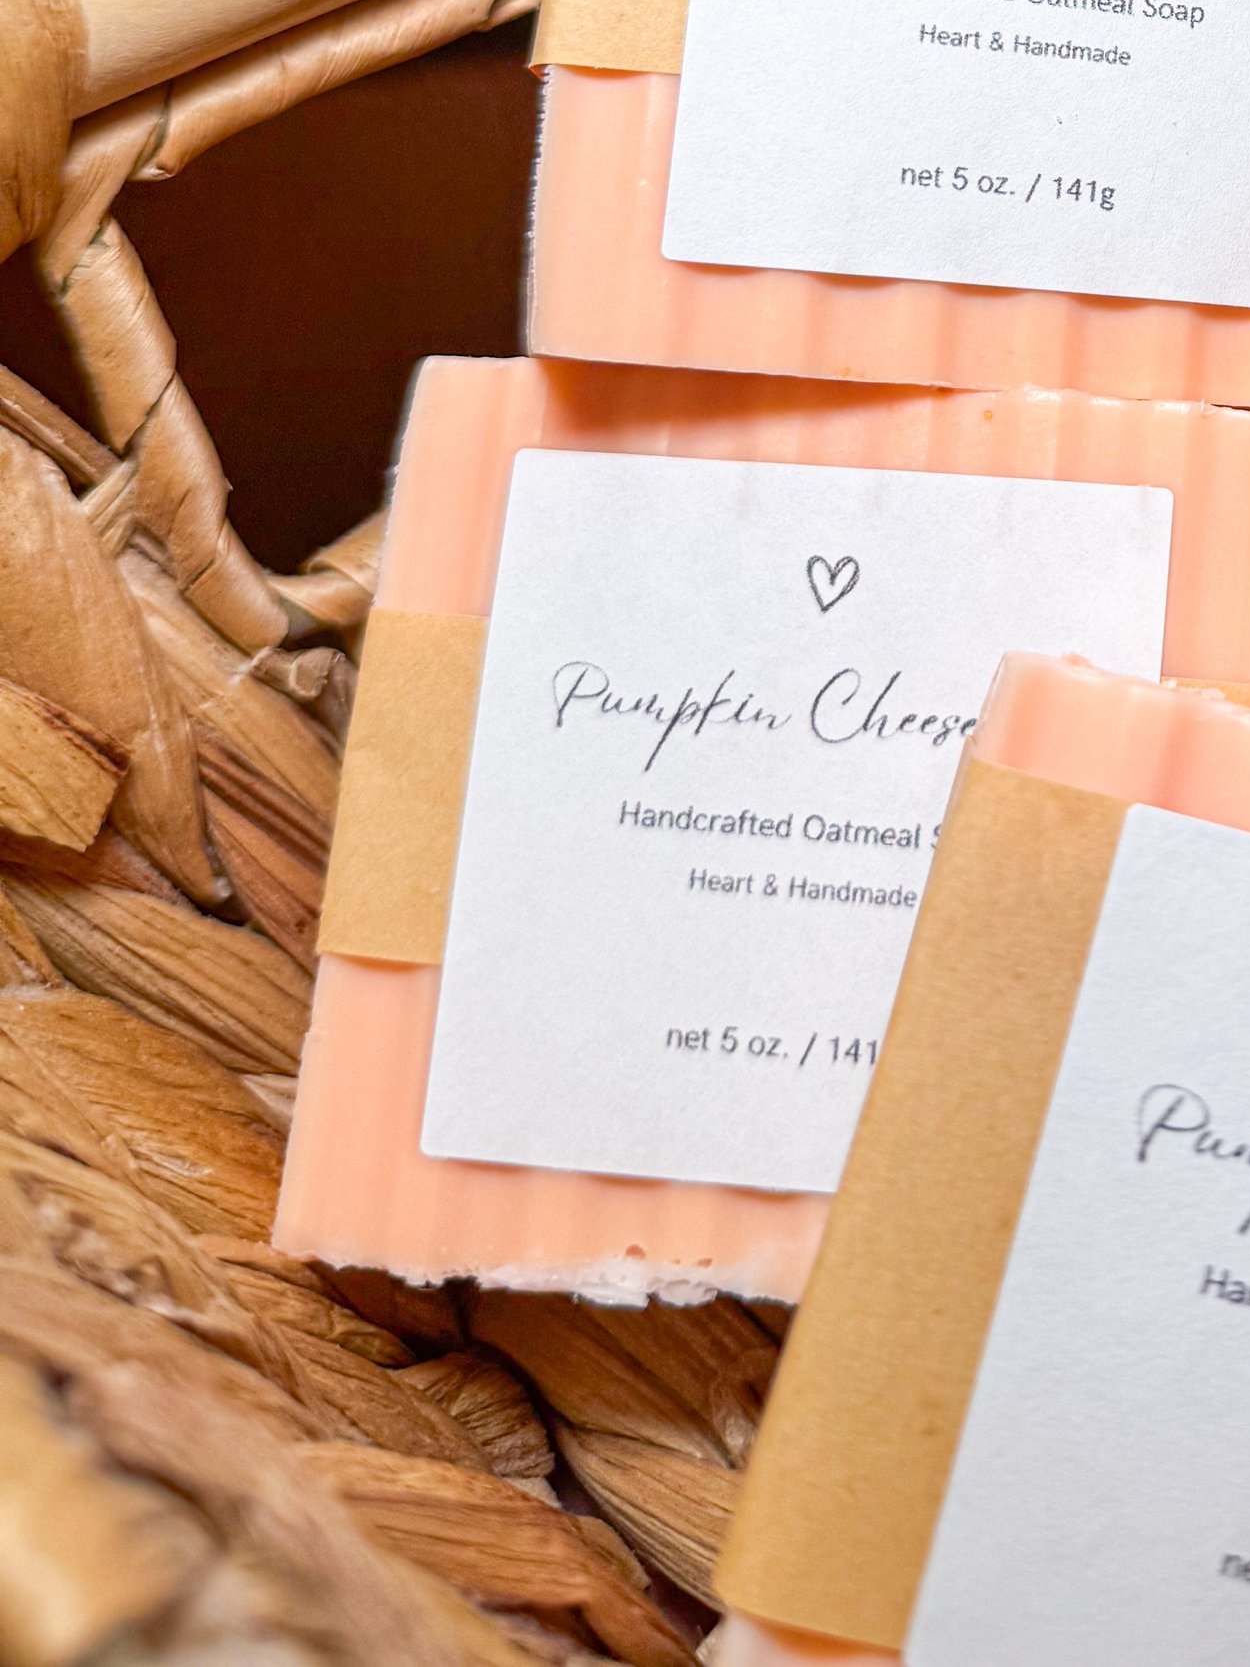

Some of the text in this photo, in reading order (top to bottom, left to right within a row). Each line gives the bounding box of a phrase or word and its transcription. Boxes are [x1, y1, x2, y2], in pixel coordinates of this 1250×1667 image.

[919, 24, 1131, 66] Heart & Handmade
[900, 165, 1116, 212] net 5 oz. / 141g
[552, 661, 977, 773] Pumpkin Cheese
[618, 801, 793, 839] Handcrafted
[802, 814, 921, 849] Oatmeal
[688, 868, 917, 908] Heart & Handmade
[666, 1025, 877, 1068] net 5 oz. / 141
